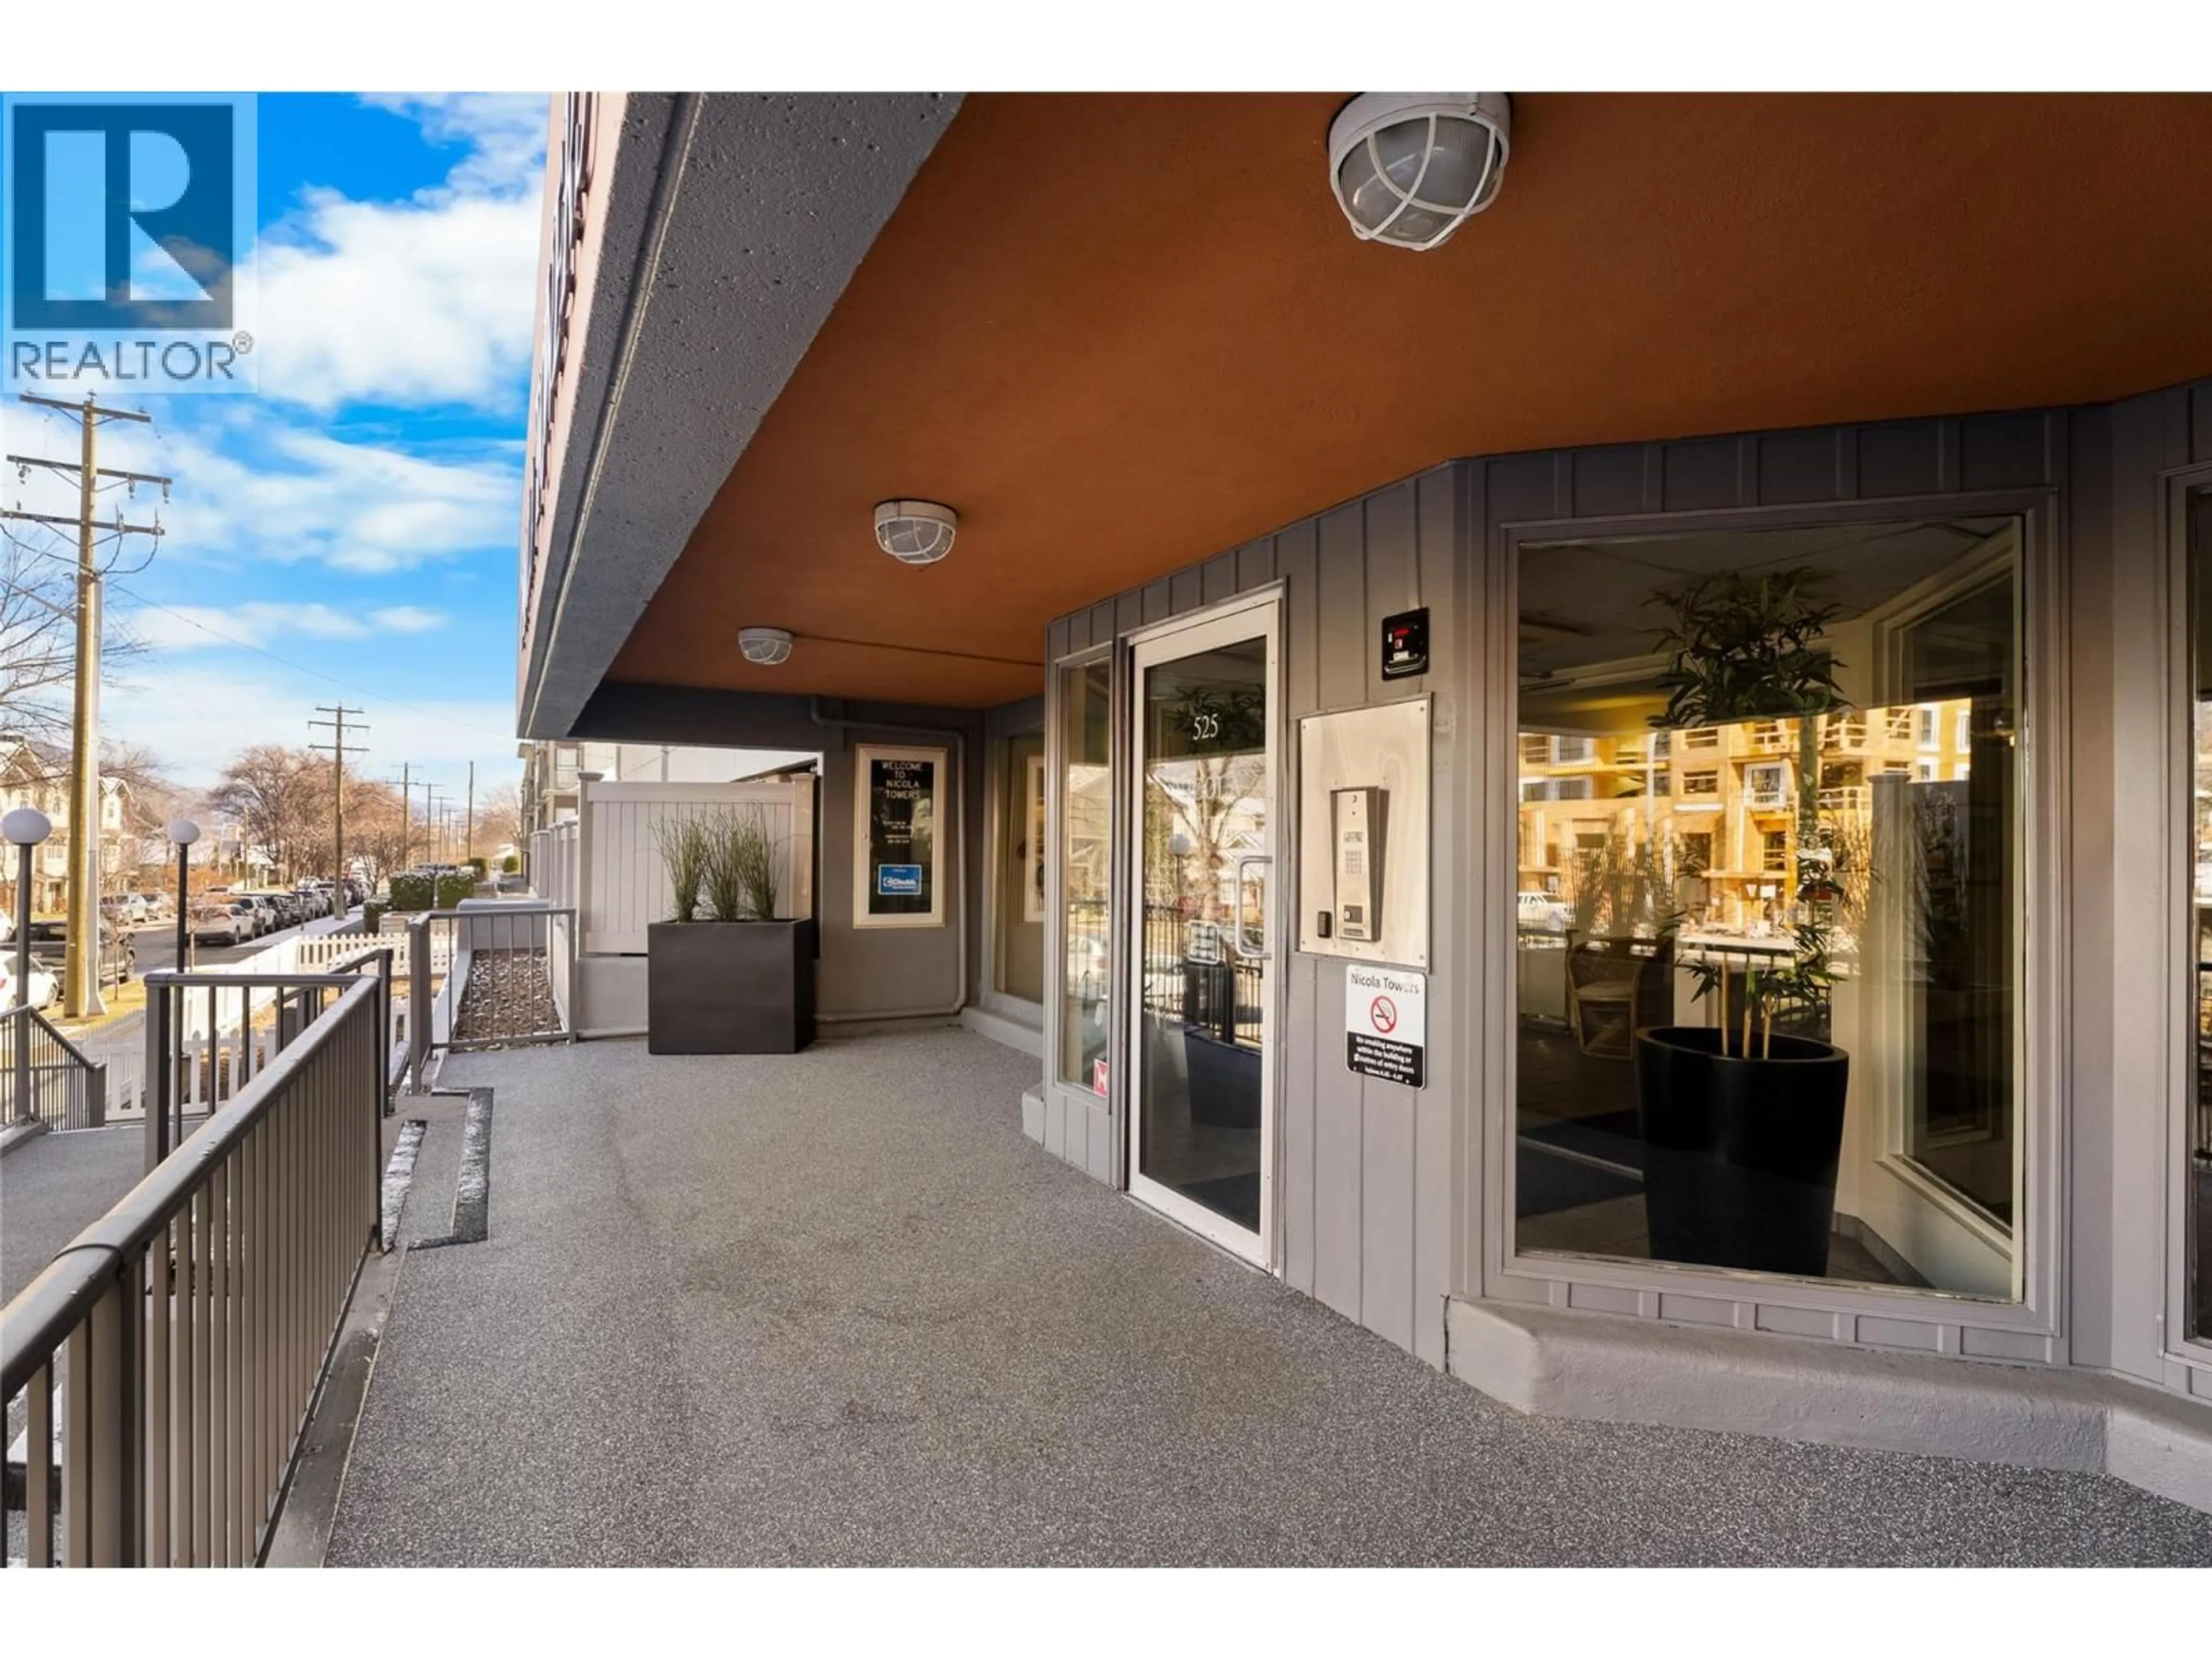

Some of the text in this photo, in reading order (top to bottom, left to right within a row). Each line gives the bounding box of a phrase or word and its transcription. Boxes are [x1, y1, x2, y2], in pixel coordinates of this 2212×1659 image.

[1192, 713, 1218, 741] 525
[881, 762, 923, 771] WELCOME
[894, 771, 906, 779] TO
[886, 779, 920, 789] NICOLA
[885, 789, 921, 800] TOWERS
[1351, 974, 1381, 988] Nicola
